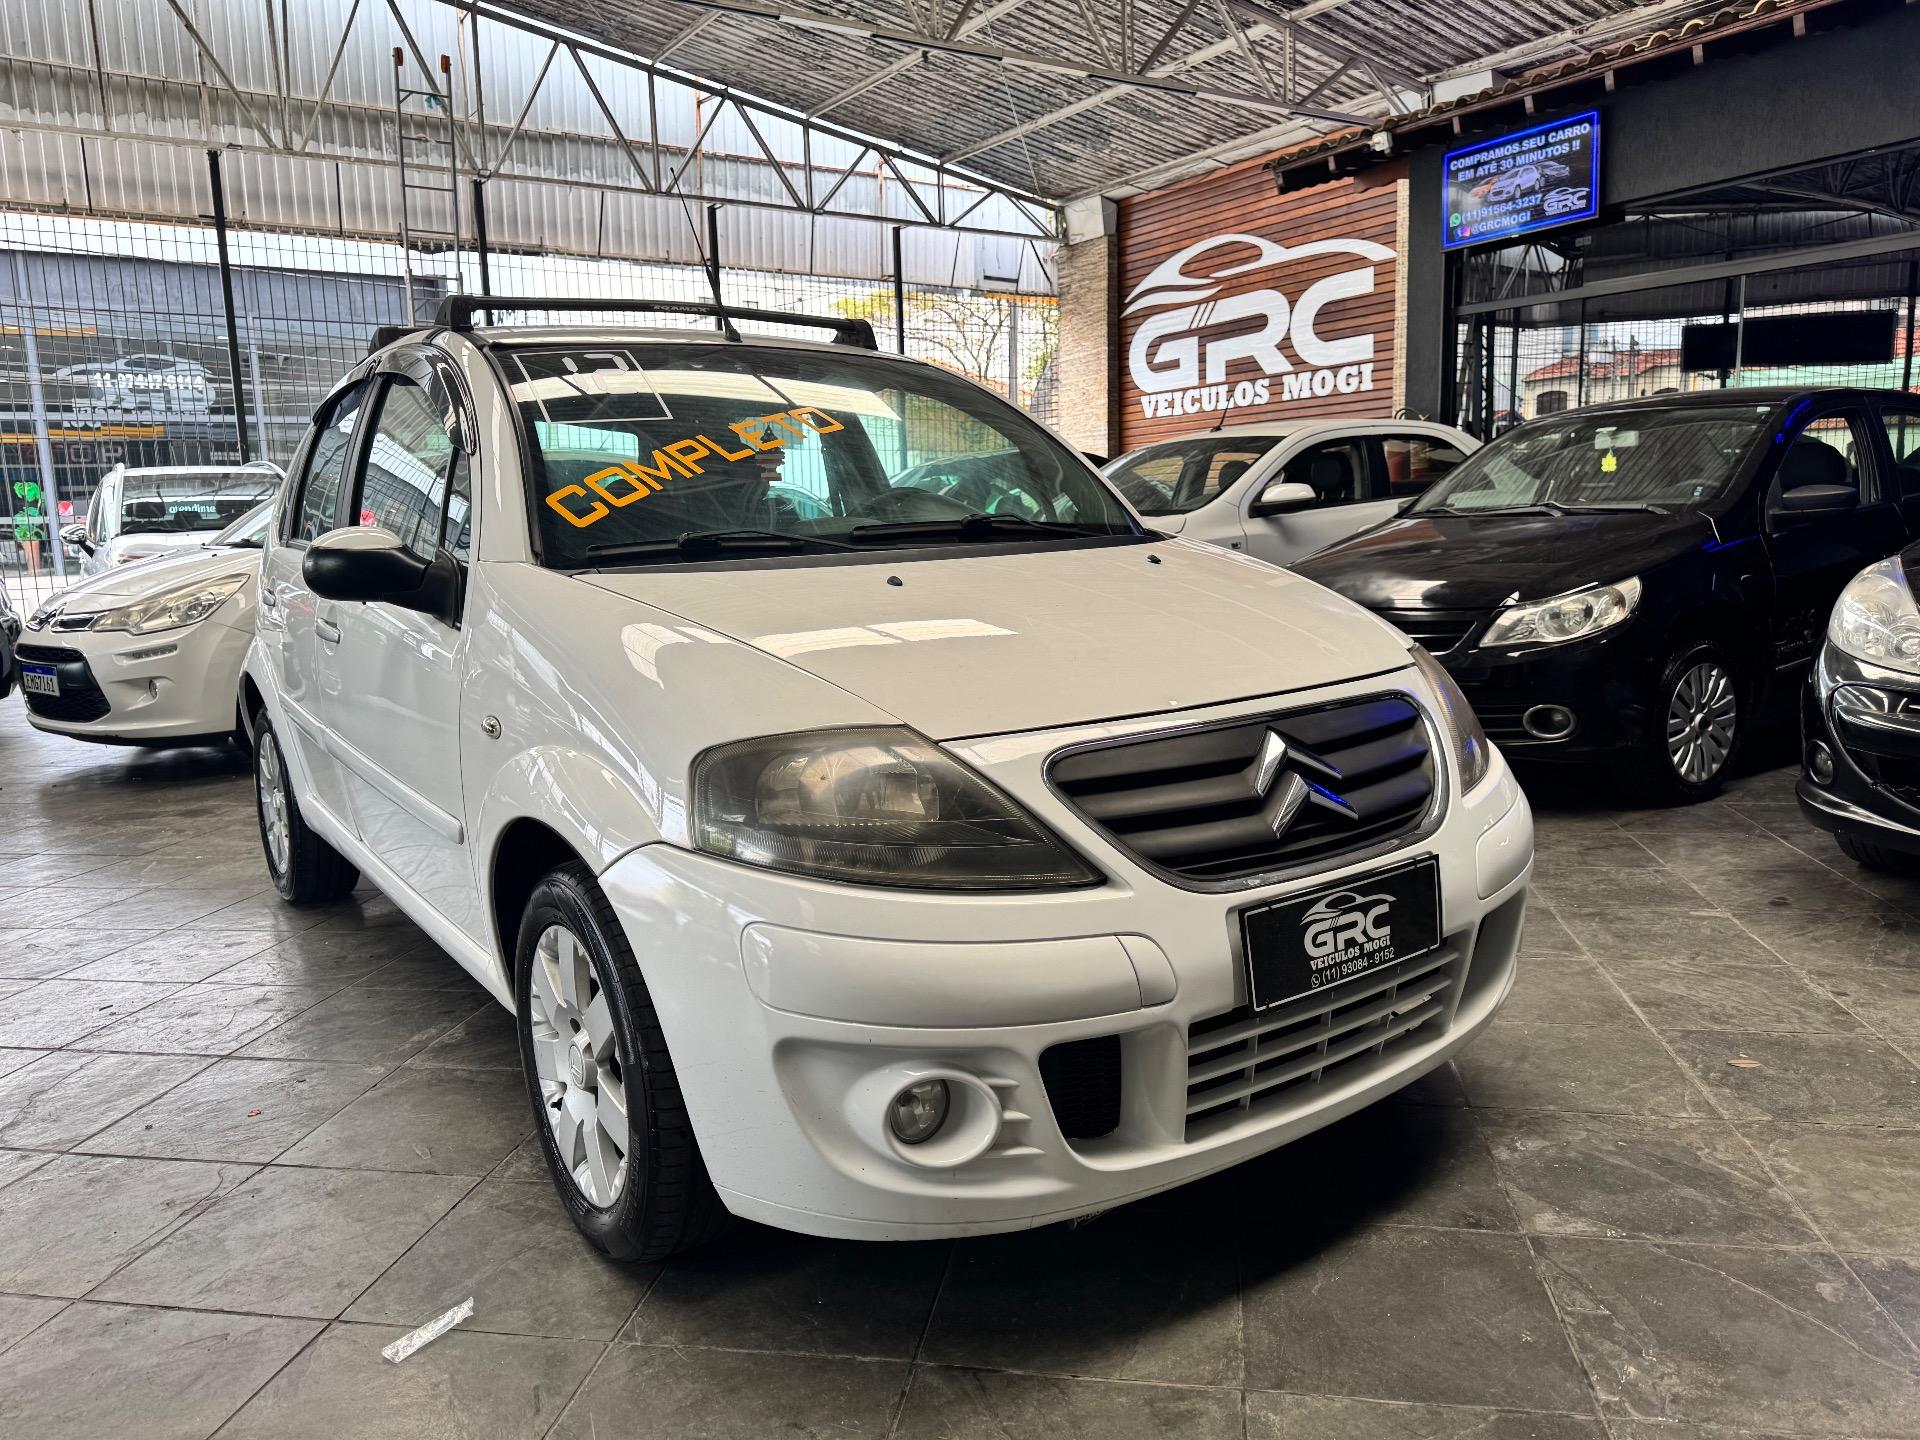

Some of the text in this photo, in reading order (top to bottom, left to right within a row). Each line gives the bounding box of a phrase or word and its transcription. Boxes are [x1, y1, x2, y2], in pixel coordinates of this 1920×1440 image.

[1450, 123, 1590, 171] COMPRAMOS SEU CARRO
[1458, 170, 1474, 181] EM
[1500, 157, 1513, 170] 30
[1516, 145, 1569, 166] MINUTOS
[1471, 211, 1531, 235] @GRCMOGI
[1544, 191, 1586, 212] GRC
[1129, 266, 1375, 393] GRC
[1140, 363, 1374, 418] VEICULOS MOGI
[545, 407, 844, 528] COMPLETO
[1304, 903, 1390, 958] GRC
[1310, 936, 1391, 971] VEICULOS MOGI
[1322, 968, 1340, 985] (11)
[1341, 959, 1368, 976] 93084
[1374, 947, 1395, 965] 9152
